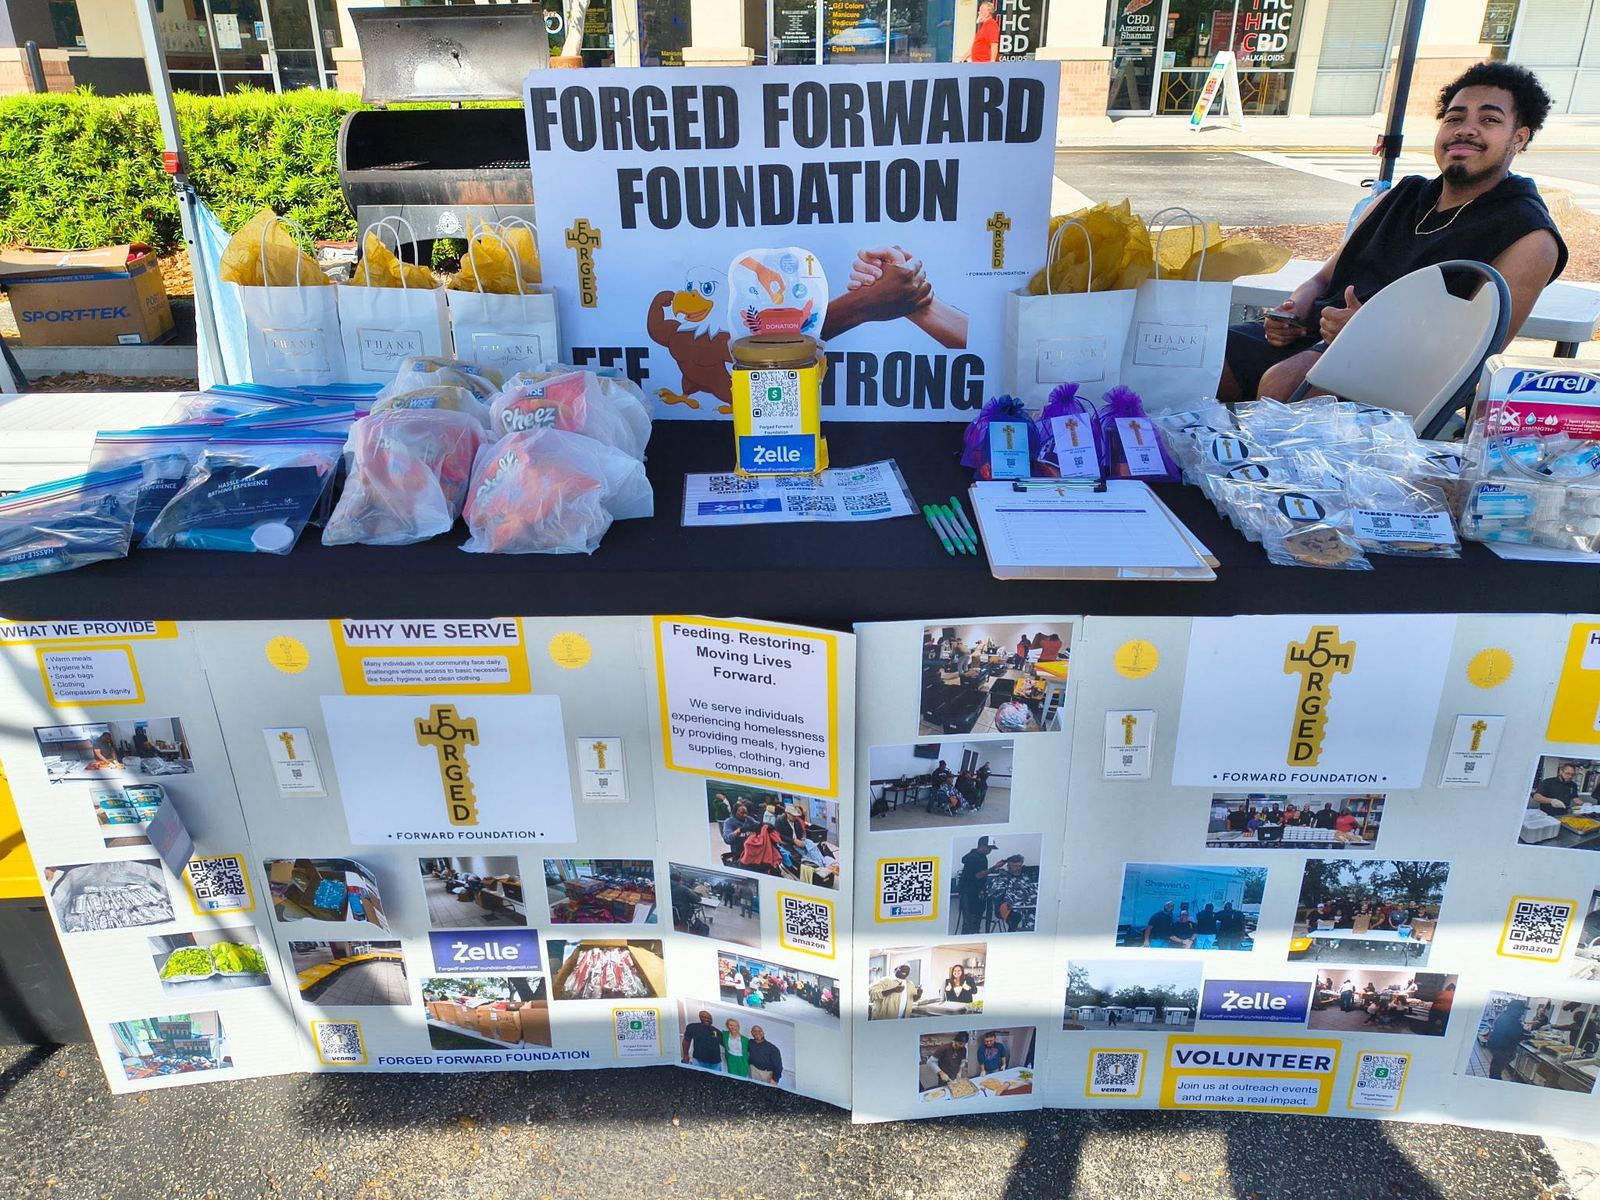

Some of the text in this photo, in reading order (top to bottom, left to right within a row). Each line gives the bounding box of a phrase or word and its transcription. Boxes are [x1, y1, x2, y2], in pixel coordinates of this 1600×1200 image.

[1127, 15, 1150, 25] CBD
[1245, 13, 1292, 31] HHC
[999, 35, 1029, 53] BD
[1121, 32, 1152, 40] Shaman
[1243, 33, 1288, 52] CBD
[530, 76, 1045, 152] FORGED FORWARD
[616, 158, 960, 230] FOUNDATION
[22, 306, 128, 323] SPORT-TEK
[364, 339, 416, 351] THANK
[1143, 334, 1199, 345] THANK
[821, 351, 985, 410] TRONG
[1521, 371, 1590, 392] Purell
[754, 445, 800, 465] Zelle
[208, 479, 269, 498] BATHING EXPERIENCE
[1, 621, 156, 638] WHAT WE PROVIDE
[342, 623, 517, 639] WHY WE SERVE
[673, 624, 815, 654] Feeding. Restoring.
[49, 655, 71, 663] Warm
[436, 659, 470, 668] community
[486, 659, 501, 667] daily
[696, 646, 792, 669] Moving Lives
[52, 664, 80, 672] Hygiene
[77, 671, 94, 680] bags
[366, 668, 399, 676] challenges
[713, 667, 776, 685] Forward.
[57, 680, 85, 689] Clothing
[379, 675, 396, 683] food,
[456, 674, 481, 682] clothing.
[59, 688, 101, 697] Compassion
[109, 687, 131, 696] dignity
[689, 698, 804, 724] We serve individuals
[672, 712, 825, 742] experiencing homelessness
[672, 725, 825, 758] by providing meals, hygiene
[688, 743, 810, 770] supplies, clothing, and
[715, 761, 784, 780] compassion.
[1222, 773, 1378, 783] FORWARD FOUNDATION
[396, 831, 536, 840] FORWARD FOUNDATION
[792, 936, 826, 950] amazon
[1513, 944, 1553, 954] amazon
[451, 941, 519, 964] Zelle
[1221, 989, 1287, 1012] Zelle
[378, 1050, 590, 1066] FORGED FORWARD FOUNDATION
[1175, 1050, 1331, 1071] VOLUNTEER
[1178, 1082, 1200, 1090] Join
[1232, 1083, 1279, 1092] outreach
[1282, 1085, 1318, 1094] events
[1182, 1094, 1202, 1102] and
[1205, 1093, 1234, 1103] make
[1247, 1095, 1268, 1104] real
